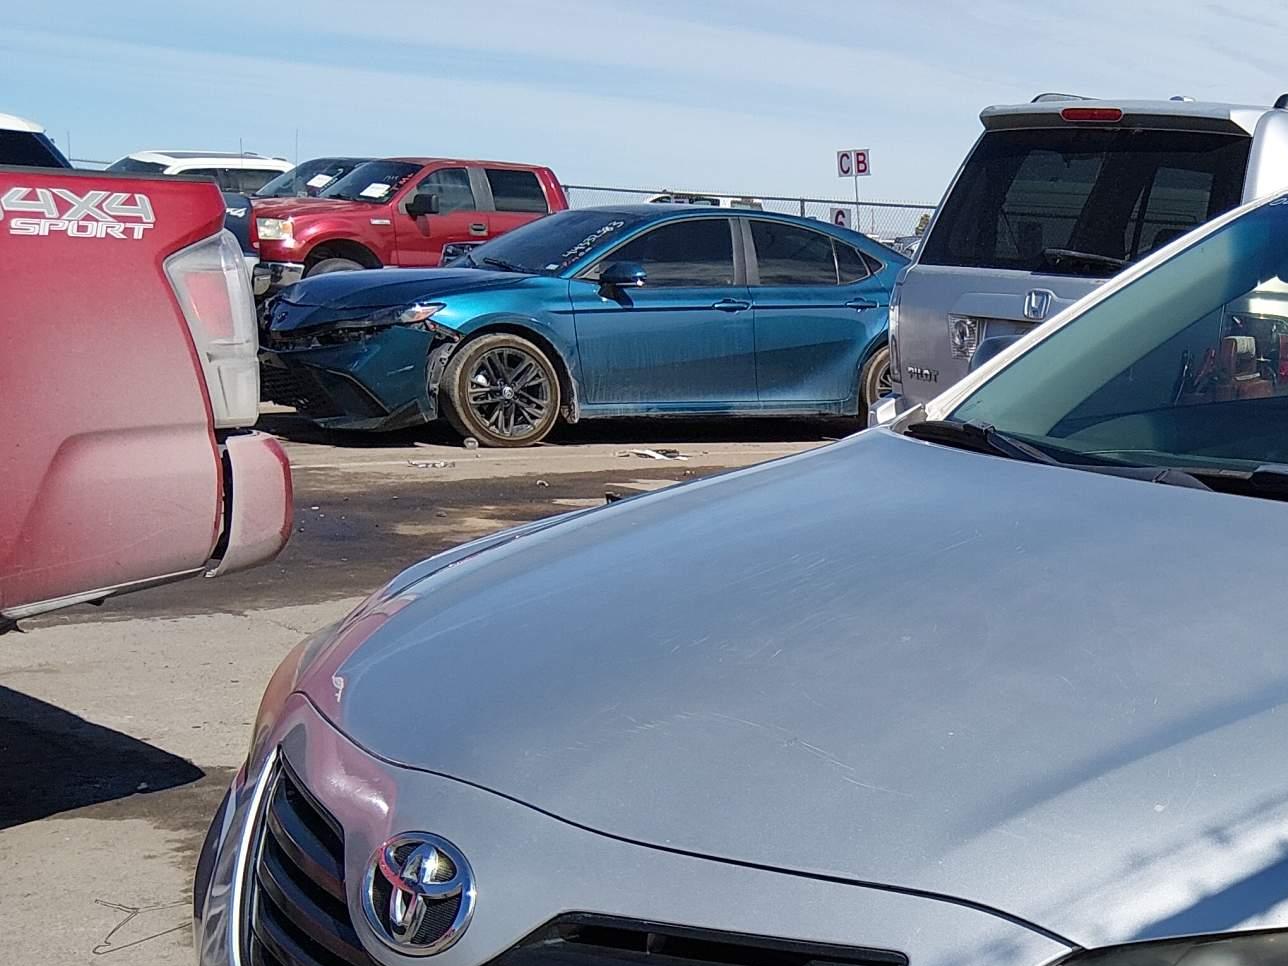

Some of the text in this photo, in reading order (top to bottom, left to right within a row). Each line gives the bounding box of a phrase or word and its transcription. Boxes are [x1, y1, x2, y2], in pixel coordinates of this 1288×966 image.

[840, 152, 867, 174] C B
[1, 187, 156, 223] 4X4
[226, 207, 248, 218] X4
[9, 218, 154, 240] SPORT
